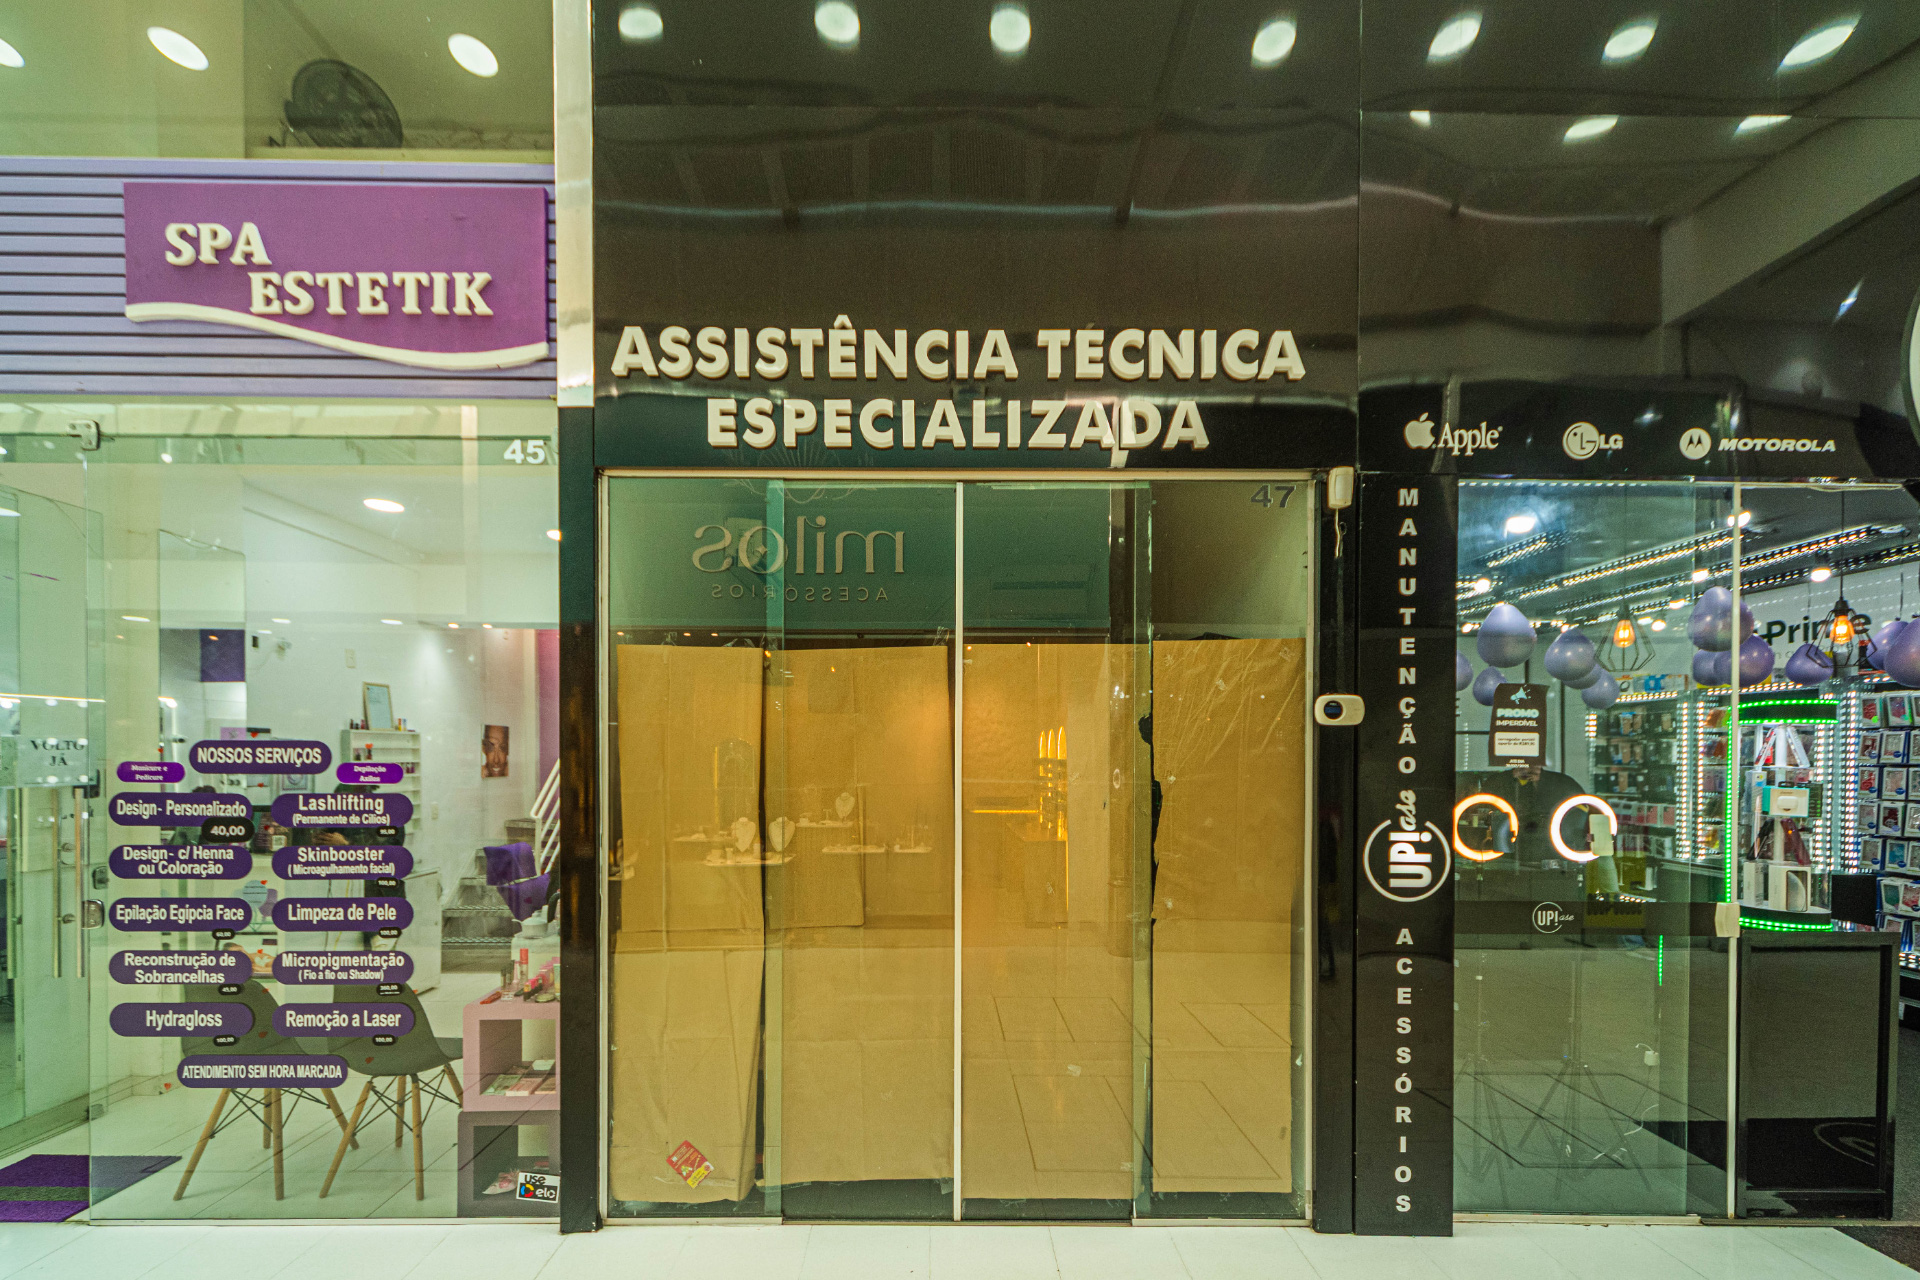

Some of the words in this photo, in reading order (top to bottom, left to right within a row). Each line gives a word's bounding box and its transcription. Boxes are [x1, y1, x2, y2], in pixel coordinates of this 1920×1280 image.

[165, 222, 272, 266] SPA
[248, 271, 494, 316] ESTETIK
[611, 314, 1019, 379] ASSISTÊNCIA
[707, 397, 1210, 449] ESPECIALIZADA
[1437, 421, 1500, 456] Apple
[1599, 433, 1624, 450] LG
[1718, 438, 1837, 452] MOTOROLA
[503, 439, 545, 464] 45
[1251, 484, 1296, 509] 47
[1398, 488, 1419, 774] MANUTENÇÃO
[1496, 708, 1540, 719] PROMO
[31, 739, 85, 751] VOLTO
[197, 747, 253, 764] NOSSOS
[255, 747, 322, 767] SERVIÇOS
[165, 799, 247, 817] Personalizado
[298, 794, 384, 814] Lashlifting
[292, 813, 348, 826] (Permanente
[349, 814, 361, 825] de
[210, 825, 246, 837] 40,00
[178, 846, 191, 860] c/
[192, 846, 234, 860] Henna
[297, 847, 385, 862] Skinbooster
[138, 864, 156, 874] ou
[158, 861, 224, 877] Coloração
[369, 863, 396, 877] facial)
[115, 904, 168, 924] Epilação
[215, 904, 245, 921] Face
[287, 903, 345, 924] Limpeza
[347, 903, 365, 921] de
[367, 903, 397, 921] Pele
[124, 952, 217, 969] Reconstrução
[218, 953, 237, 967] de
[281, 952, 405, 971] Micropigmentação
[134, 969, 226, 984] Sobrancelhas
[318, 972, 323, 980] a
[324, 969, 336, 980] fio
[337, 972, 348, 980] ou
[349, 969, 384, 982] Shadow)
[145, 1010, 223, 1031] Hydragloss
[285, 1009, 348, 1031] Remoção
[351, 1014, 360, 1027] a
[363, 1010, 401, 1028] Laser
[182, 1065, 246, 1079] ATENDIMENTO
[248, 1065, 267, 1079] SEM
[269, 1065, 295, 1079] HORA
[297, 1065, 342, 1079] MARCADA
[1395, 928, 1413, 1212] ACESSÓRIOS
[524, 1174, 546, 1185] use
